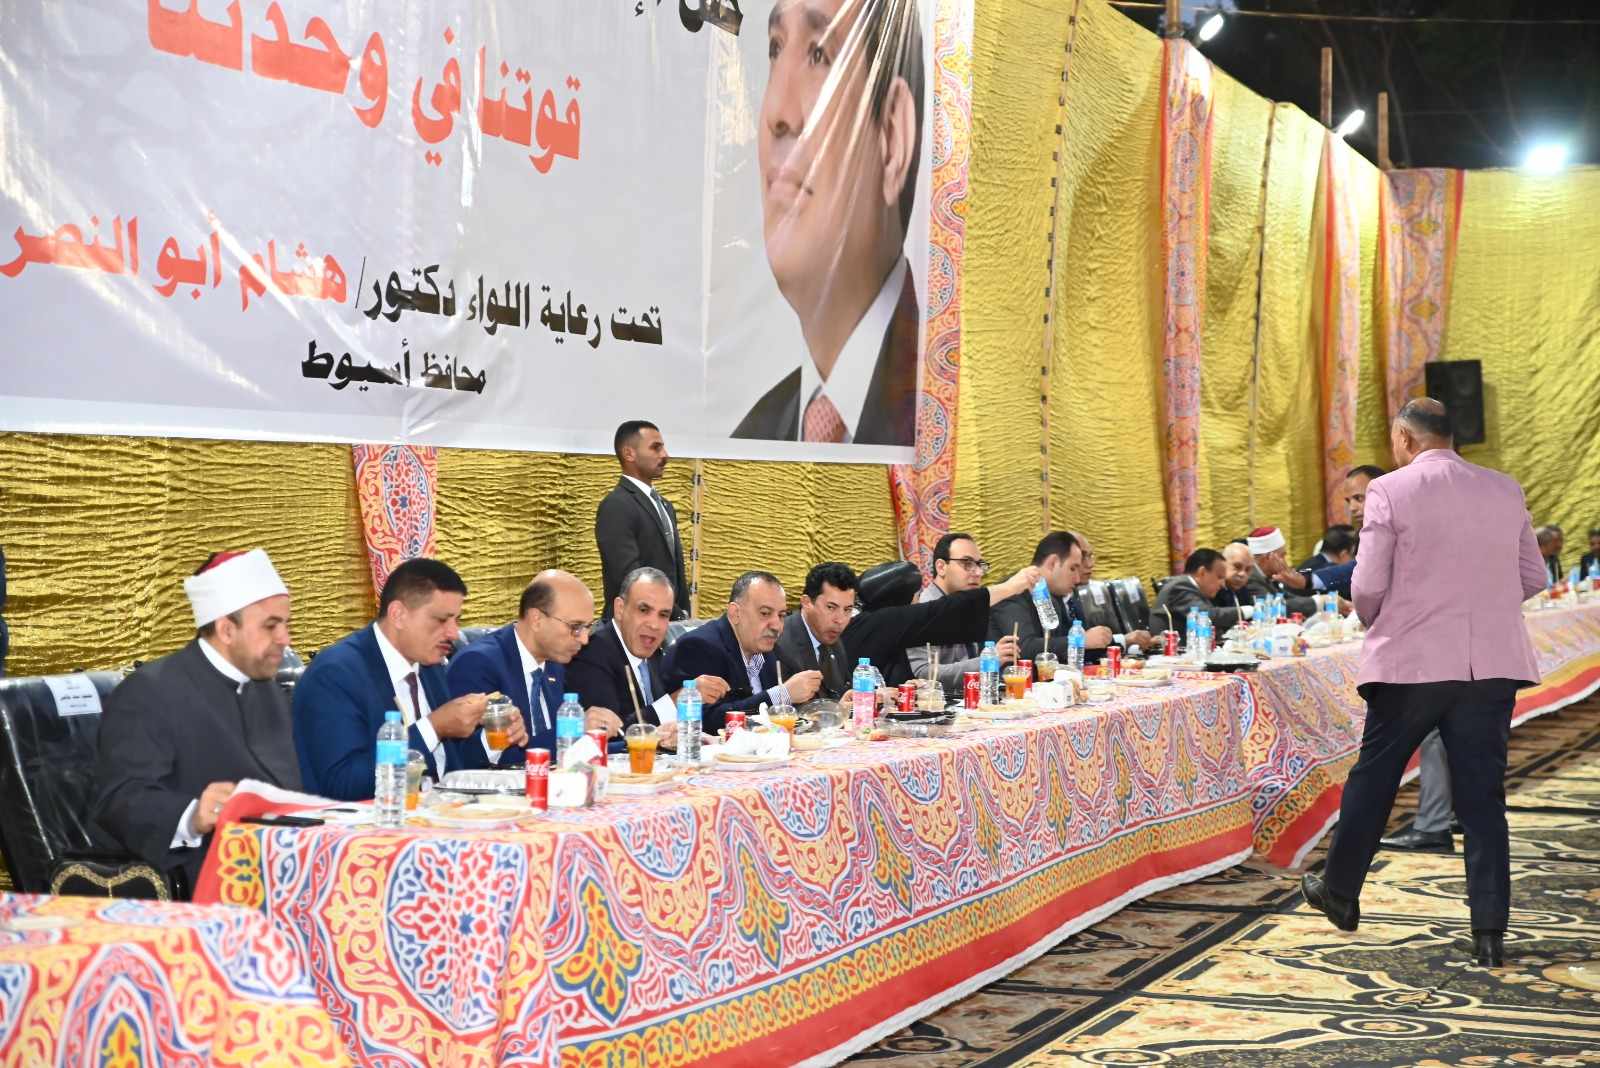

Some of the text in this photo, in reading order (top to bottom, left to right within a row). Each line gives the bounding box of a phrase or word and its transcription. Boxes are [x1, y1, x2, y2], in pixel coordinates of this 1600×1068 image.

[411, 26, 462, 166] في
[479, 44, 581, 174] قوتنا
[0, 214, 139, 278] النصر
[239, 239, 347, 312] هشام
[467, 273, 531, 335] اللواء
[540, 284, 601, 349] رعاية
[610, 305, 663, 345] تحت
[301, 338, 487, 394] محافظ أسيوط
